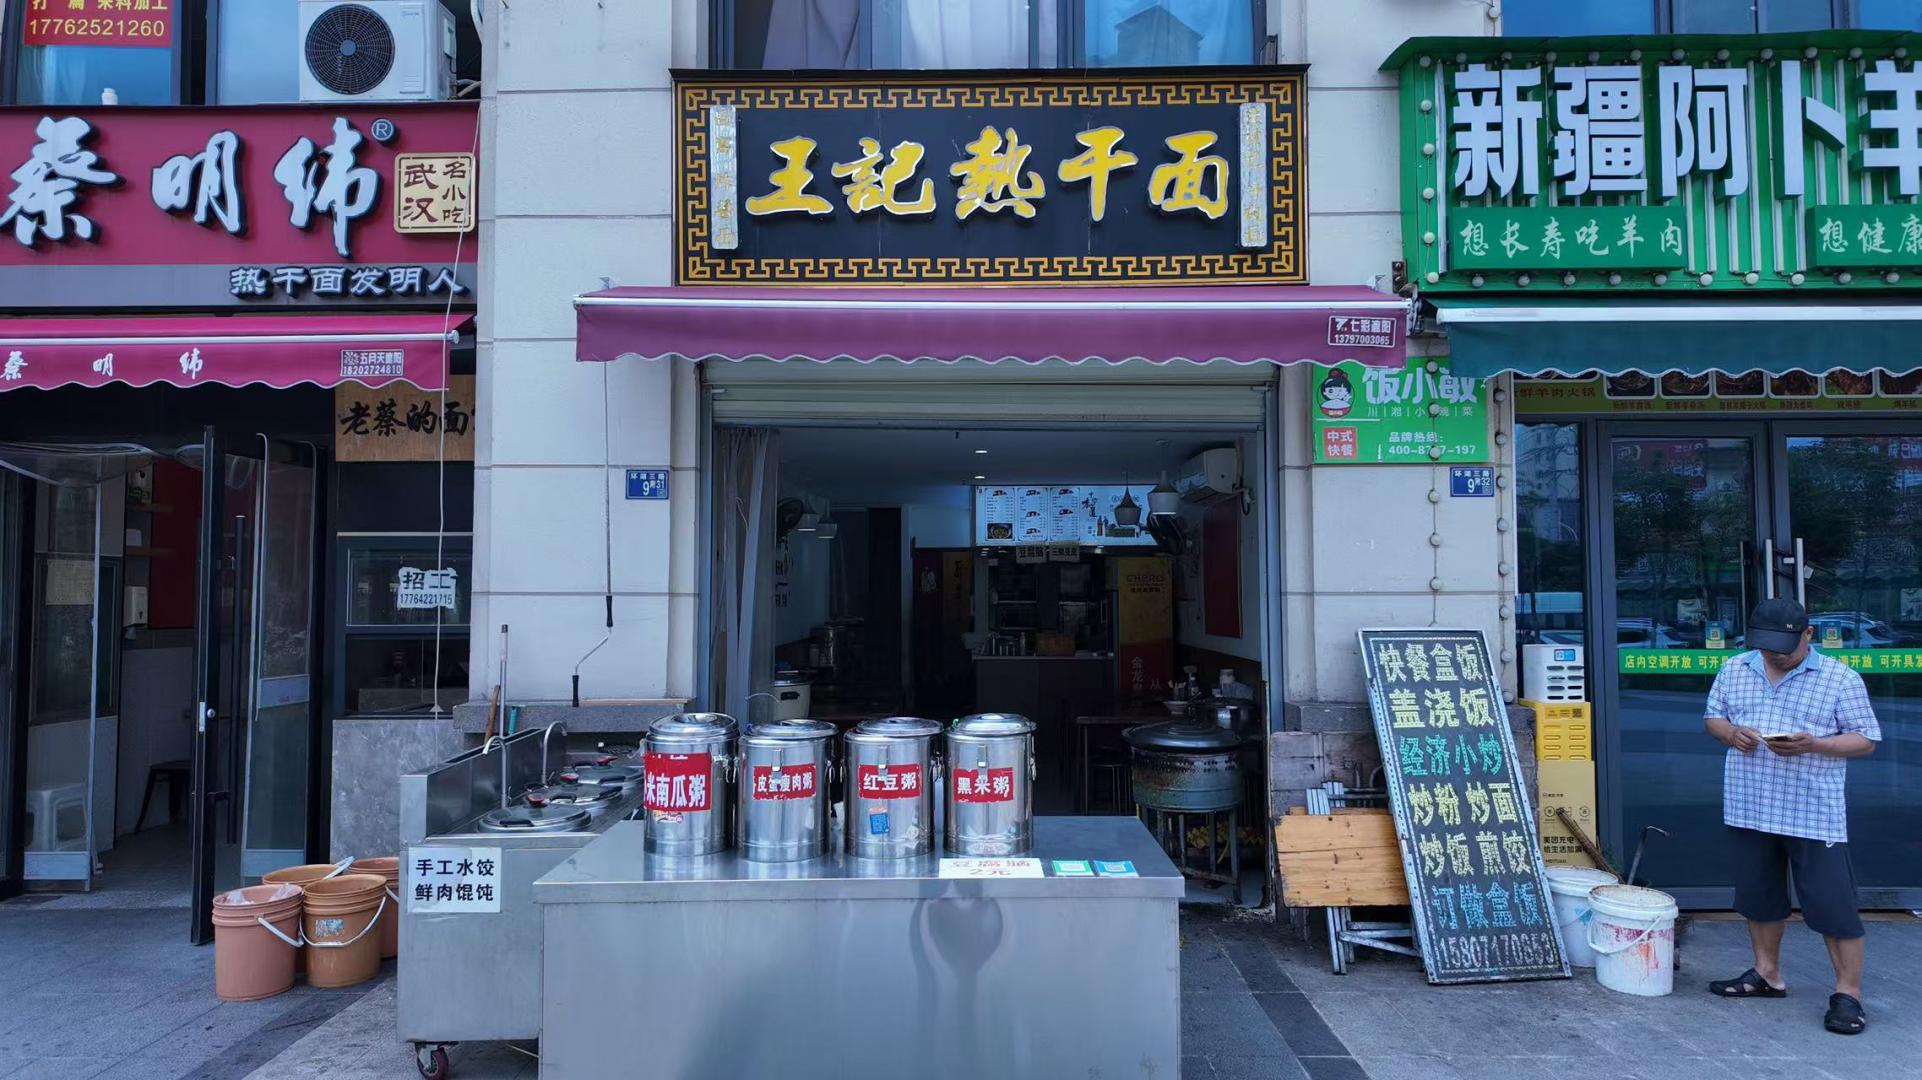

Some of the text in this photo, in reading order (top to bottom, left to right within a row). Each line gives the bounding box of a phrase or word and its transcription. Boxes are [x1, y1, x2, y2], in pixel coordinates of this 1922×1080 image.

[30, 19, 165, 36] 17762521260
[0, 116, 379, 257] 蔡明纬
[404, 162, 439, 223] 武汉
[442, 161, 466, 223] 名小吃
[1459, 216, 1684, 259] 想长寿吃羊肉
[1818, 219, 1922, 256] 想健康
[229, 267, 467, 296] 热干面发明人
[0, 348, 204, 380] 蔡明纬
[343, 365, 402, 375] 18202724810
[1515, 387, 1597, 398] 鲜羊肉火锅
[338, 398, 475, 437] 老蔡的面
[1327, 430, 1353, 442] 中式
[1327, 444, 1353, 457] 快餐
[1388, 445, 1476, 455] 400-877-197
[402, 571, 452, 590] 招工
[1379, 643, 1483, 683] 快餐盒饭
[1624, 655, 1692, 669] 店内空调开放
[1830, 653, 1873, 669] 调开放
[1399, 733, 1504, 777] 经济小炒
[644, 771, 706, 808] 米南瓜粥
[757, 772, 813, 793] 皮蛋瘦肉粥
[863, 771, 916, 791] 红豆粥
[1408, 782, 1518, 827] 炒粉 炒面
[415, 858, 495, 878] 手工水饺
[1419, 833, 1474, 878] 炒饭
[415, 883, 495, 902] 鲜肉馄饨
